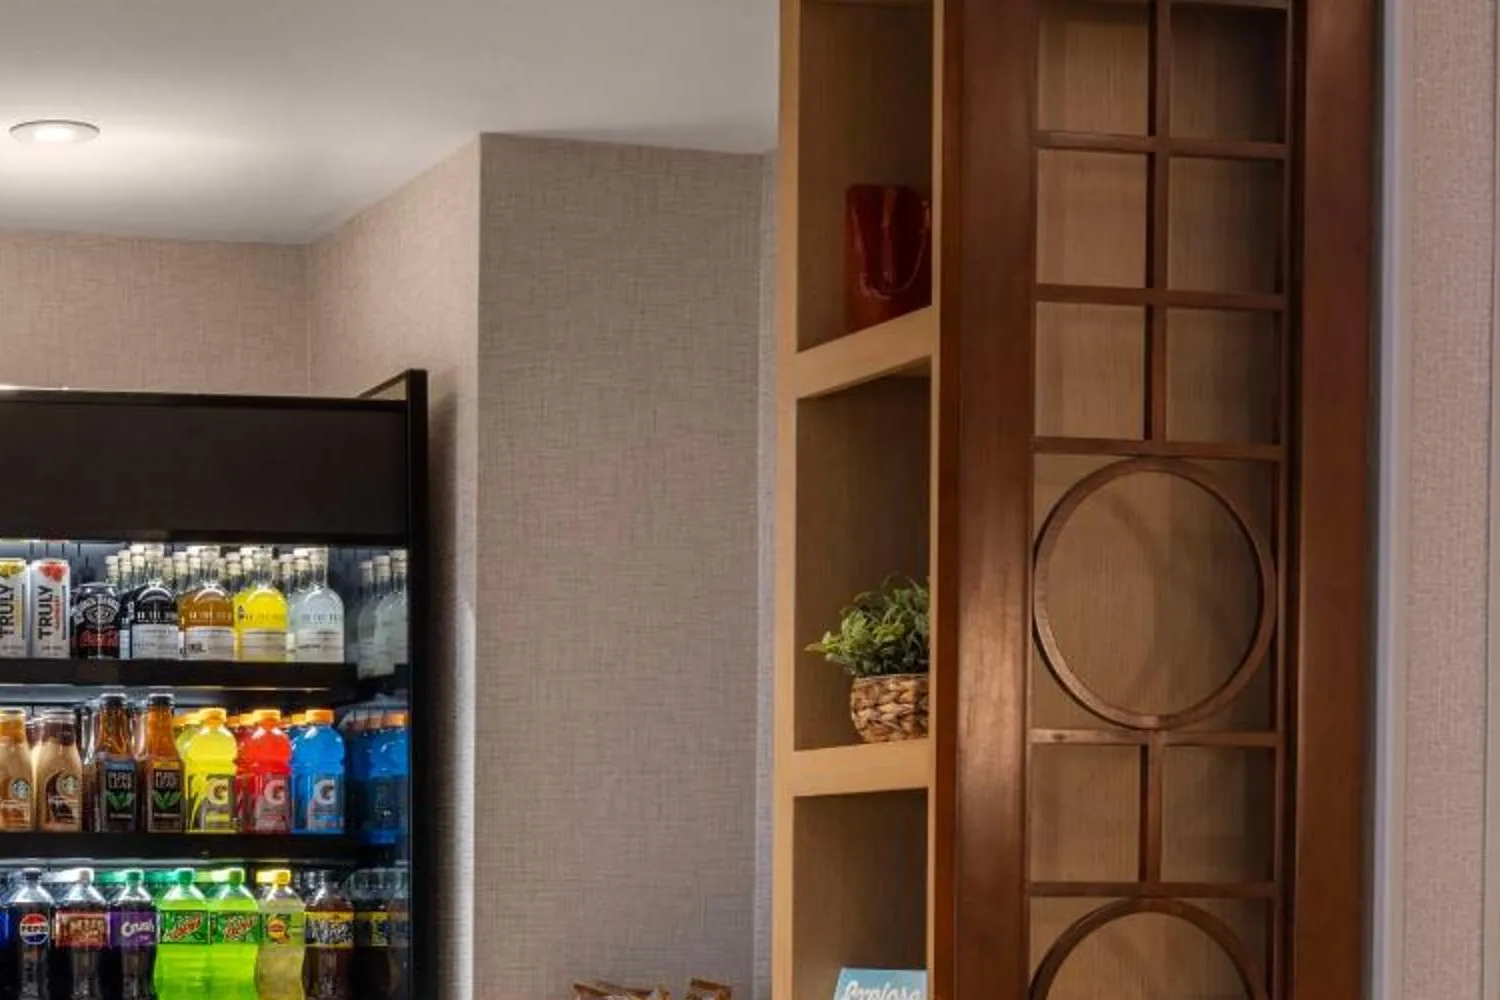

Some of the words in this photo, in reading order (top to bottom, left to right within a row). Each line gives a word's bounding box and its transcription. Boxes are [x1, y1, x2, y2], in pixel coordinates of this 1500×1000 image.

[37, 585, 53, 641] TRULY
[264, 778, 285, 805] G
[313, 778, 336, 805] G
[21, 924, 48, 934] PEPSI
[120, 920, 155, 938] Crush
